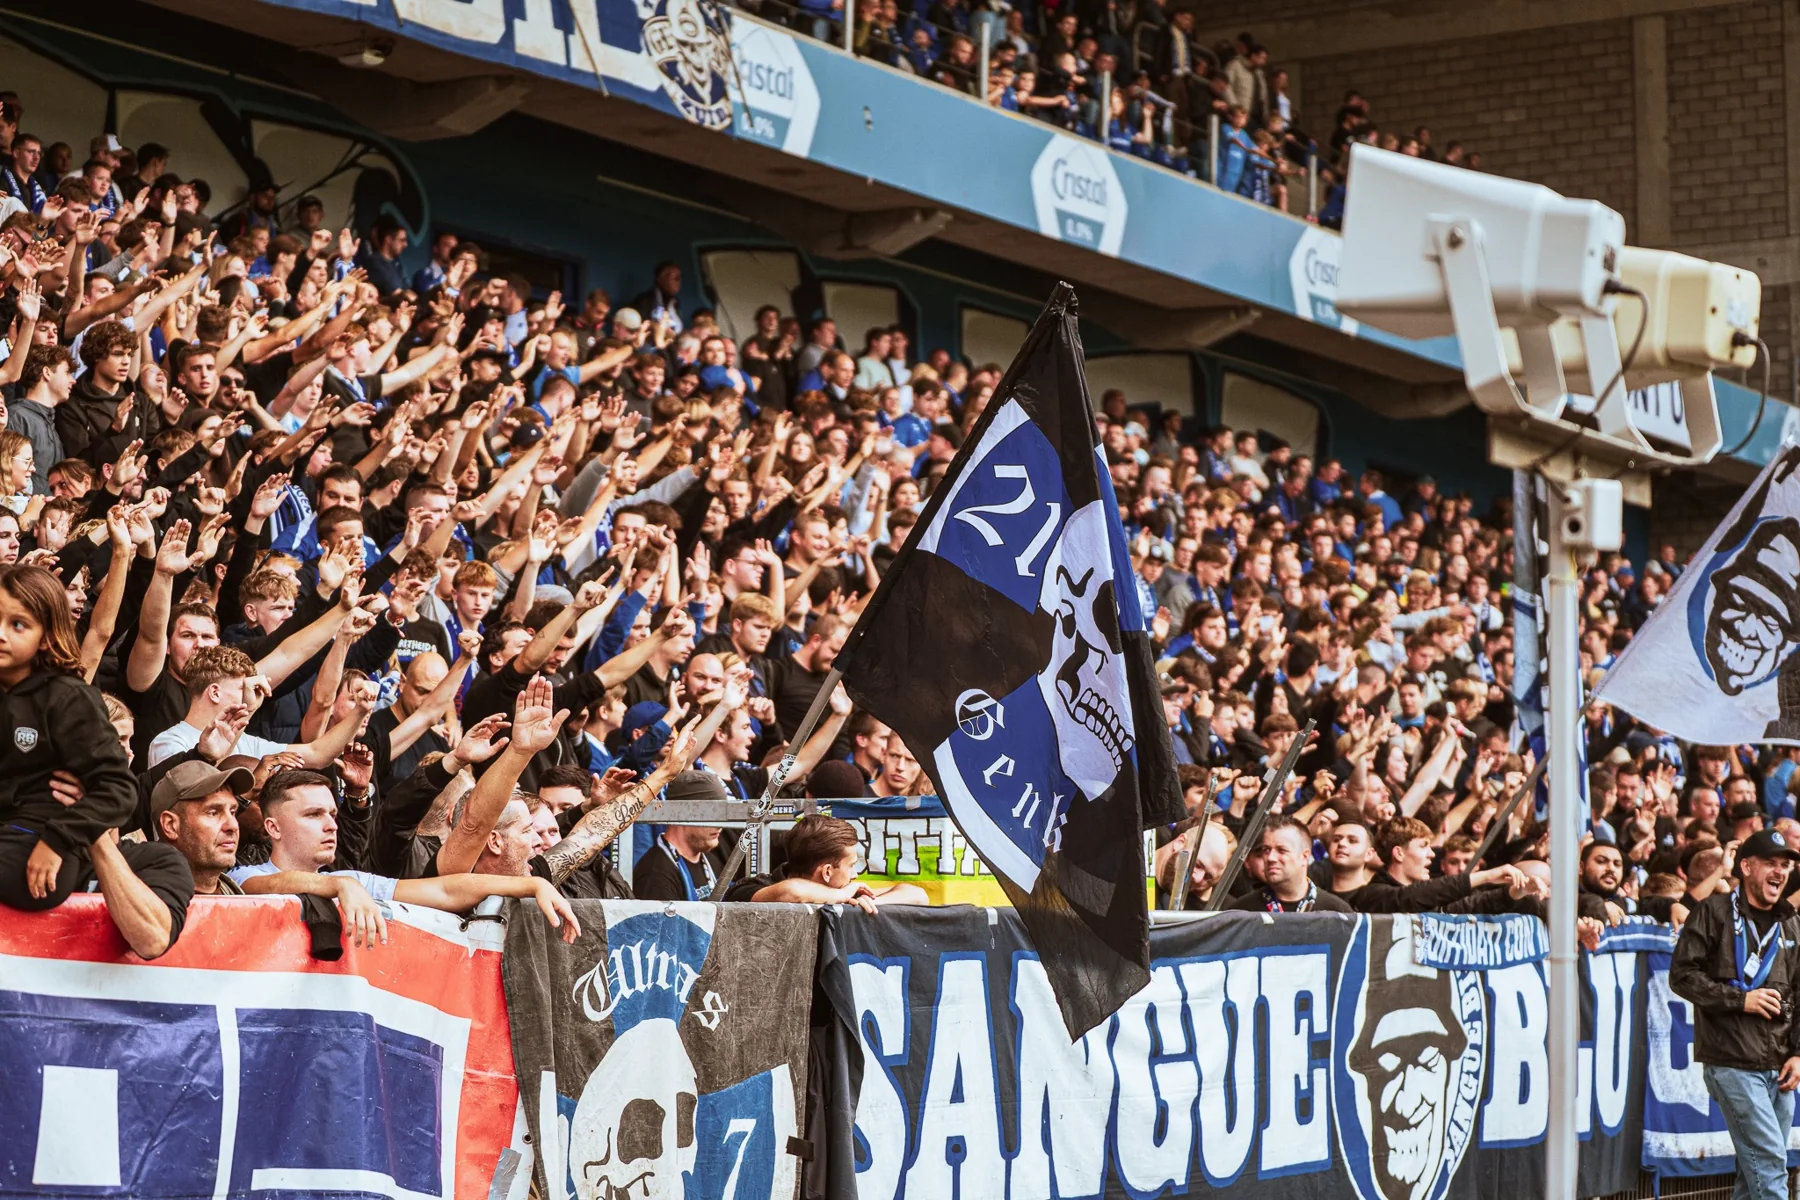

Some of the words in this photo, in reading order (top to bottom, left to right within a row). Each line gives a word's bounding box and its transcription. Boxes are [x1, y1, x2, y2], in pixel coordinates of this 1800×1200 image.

[1051, 157, 1107, 207] Cristal
[954, 687, 1068, 853] Genk
[1505, 915, 1536, 962] CON
[572, 940, 732, 1032] Ultras
[849, 950, 1331, 1200] SANGUE
